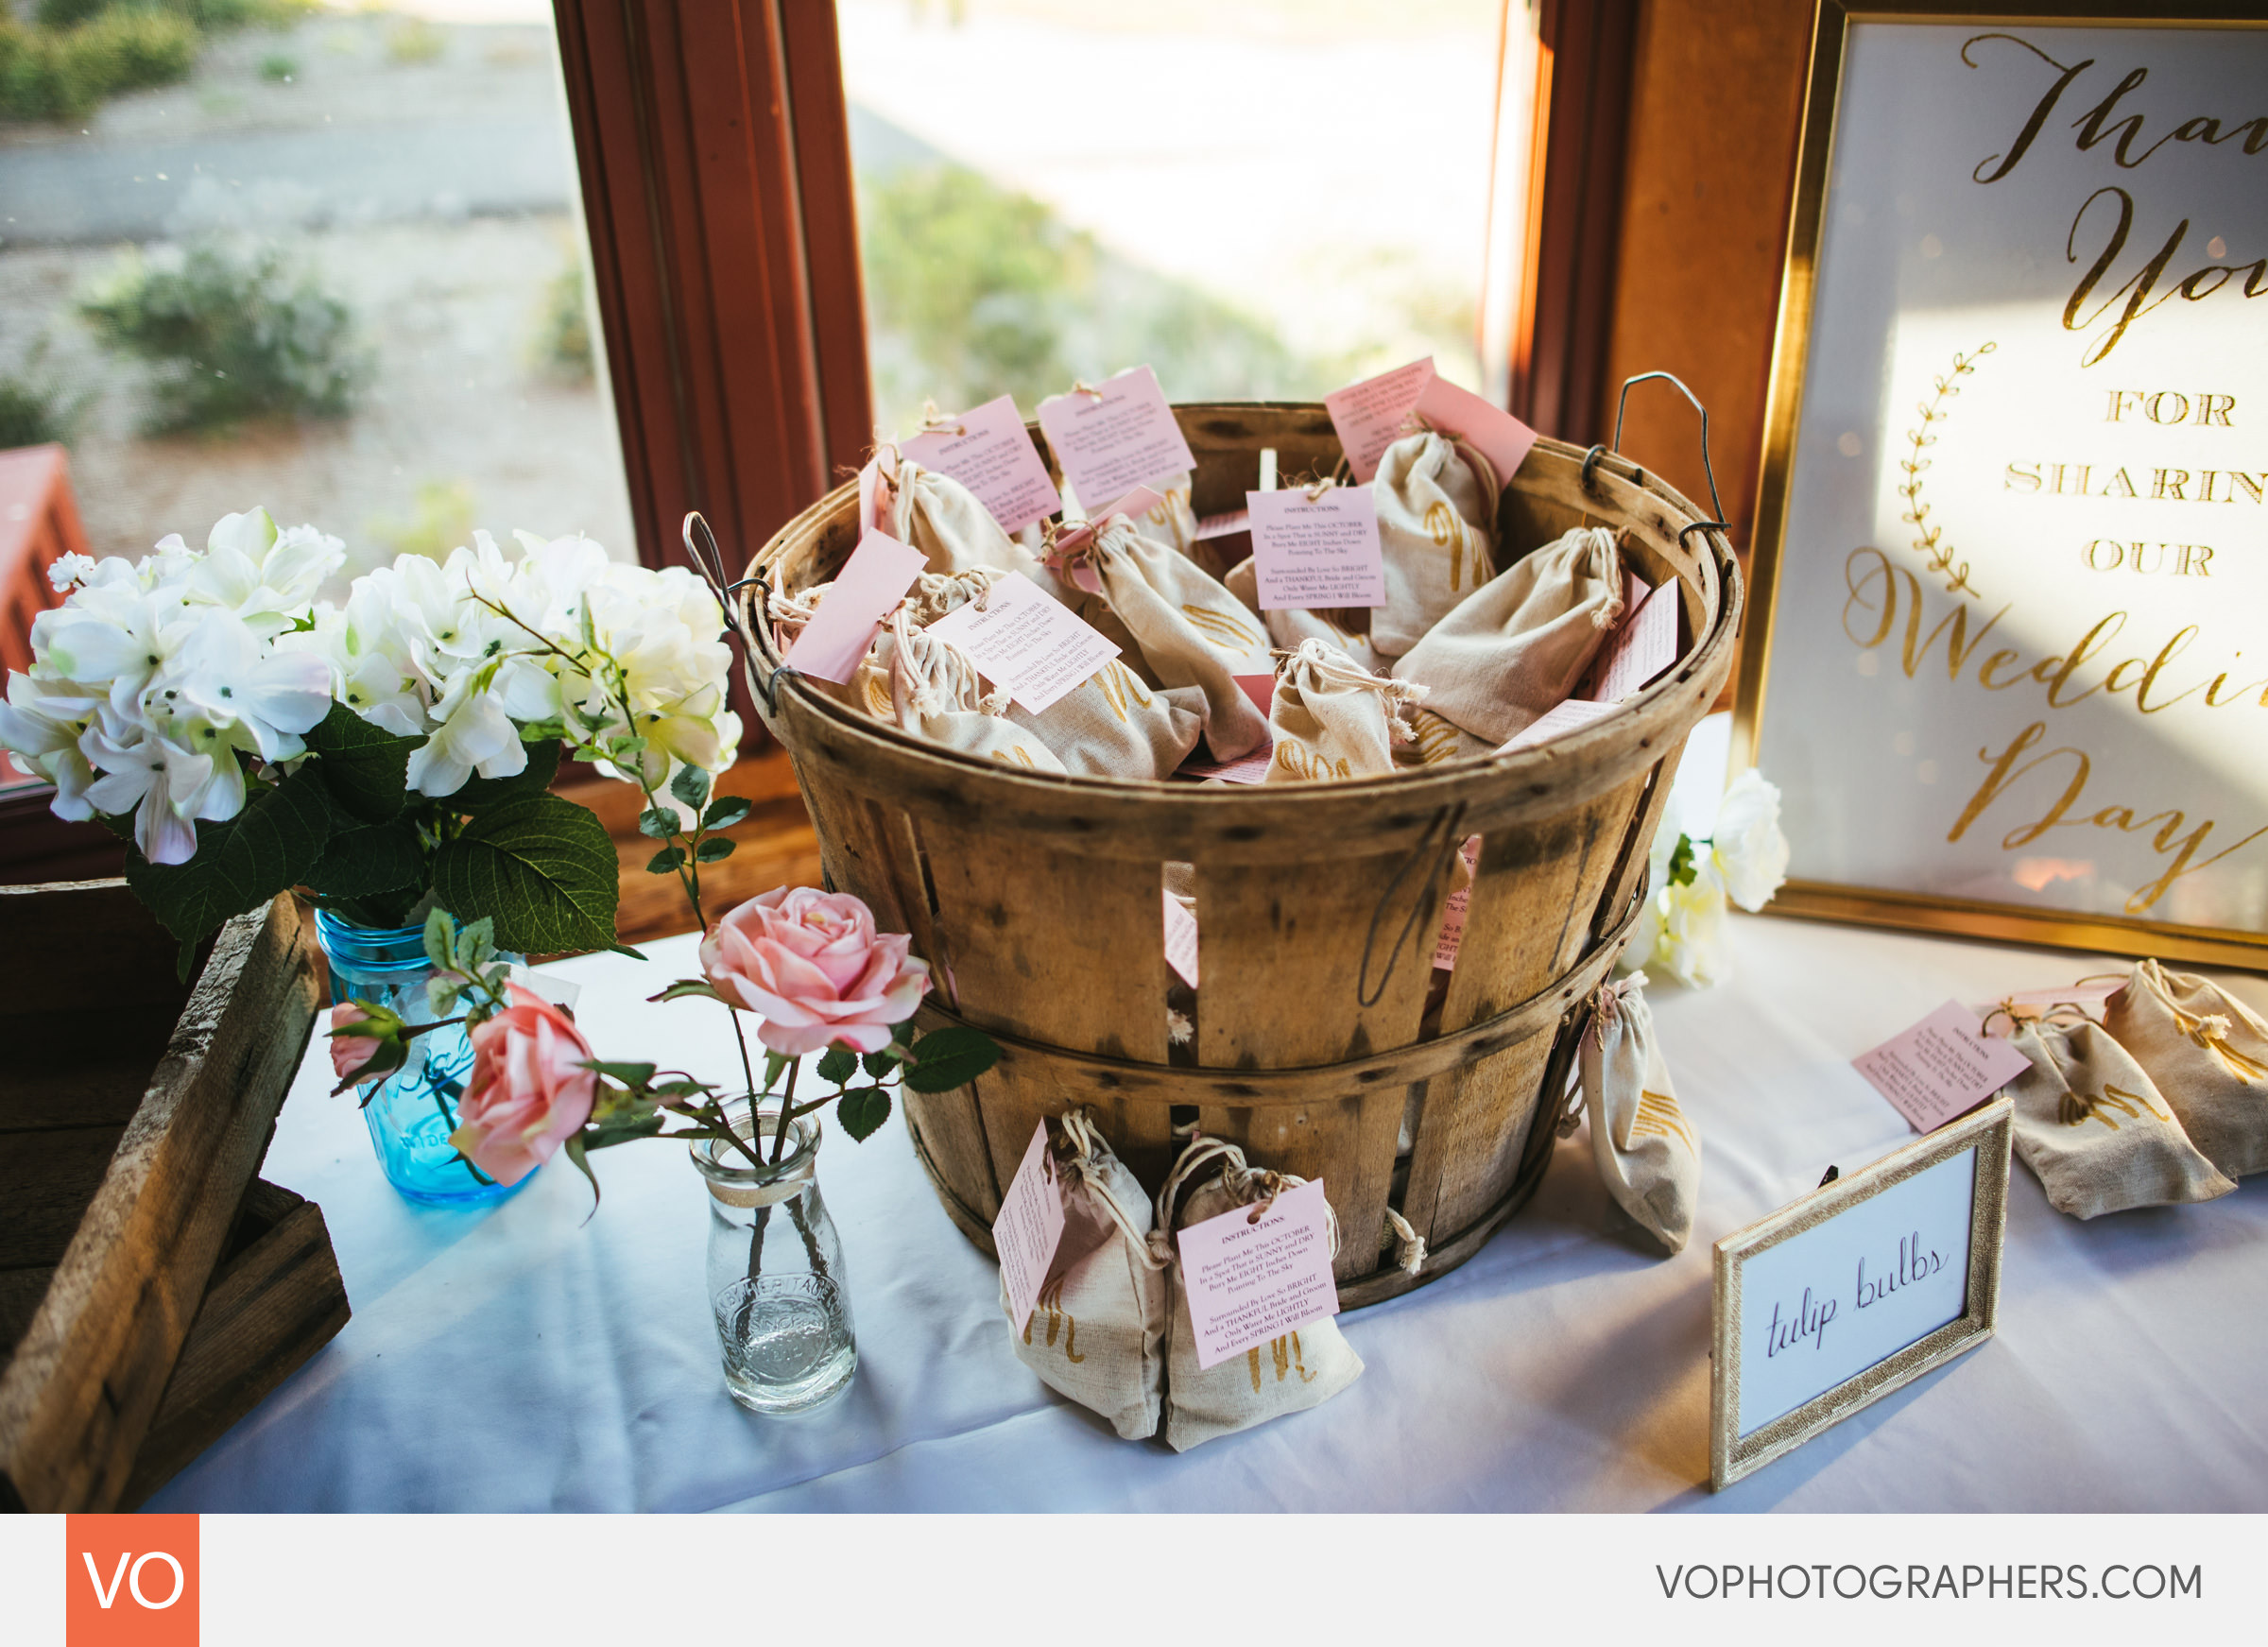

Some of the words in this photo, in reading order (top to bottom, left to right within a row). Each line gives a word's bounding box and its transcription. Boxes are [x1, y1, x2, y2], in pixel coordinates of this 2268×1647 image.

[2104, 390, 2236, 426] FOR
[2082, 539, 2214, 576] OUR
[1843, 546, 2268, 713] Weddi
[1947, 721, 2268, 915] Day
[1200, 1259, 1222, 1273] Please
[1223, 1251, 1241, 1264] Plant
[1242, 1246, 1253, 1257] Me
[1255, 1240, 1269, 1252] This
[1270, 1225, 1310, 1246] OCTOBER
[1221, 1214, 1285, 1244] INSTRUCTIONS
[1198, 1275, 1207, 1283] In
[1213, 1266, 1230, 1279] Spot
[1231, 1260, 1246, 1271] That
[1255, 1245, 1282, 1261] SUNNY
[1283, 1240, 1297, 1250] and
[1297, 1233, 1314, 1244] DRY
[1208, 1278, 1225, 1292] Bury
[1226, 1273, 1237, 1283] Me
[1238, 1263, 1263, 1278] EIGHT
[1265, 1254, 1286, 1268] Inches
[1287, 1245, 1308, 1259] Down
[1227, 1277, 1256, 1295] Pointing
[1257, 1272, 1265, 1281] To
[1267, 1266, 1280, 1278] The
[1280, 1261, 1293, 1274] Sky
[1203, 1324, 1218, 1336] And
[1226, 1303, 1268, 1328] THANKFUL
[1269, 1295, 1287, 1310] Bride
[1288, 1290, 1301, 1301] and
[1302, 1279, 1326, 1296] Groom
[1208, 1300, 1249, 1323] Surrounded
[1249, 1296, 1259, 1308] By
[1260, 1290, 1275, 1302] Love
[1276, 1286, 1285, 1295] So
[1286, 1273, 1316, 1292] BRIGHT
[1224, 1326, 1242, 1340] Only
[1243, 1317, 1263, 1331] Water
[1263, 1312, 1275, 1322] Me
[1276, 1297, 1309, 1317] LIGHTLY
[1765, 1287, 1837, 1358] tulip
[1854, 1231, 1950, 1312] bulbs
[1213, 1342, 1229, 1354] And
[1230, 1333, 1248, 1348] Every
[1249, 1321, 1279, 1339] SPRING
[1284, 1312, 1299, 1325] Will
[1300, 1303, 1322, 1318] Bloom
